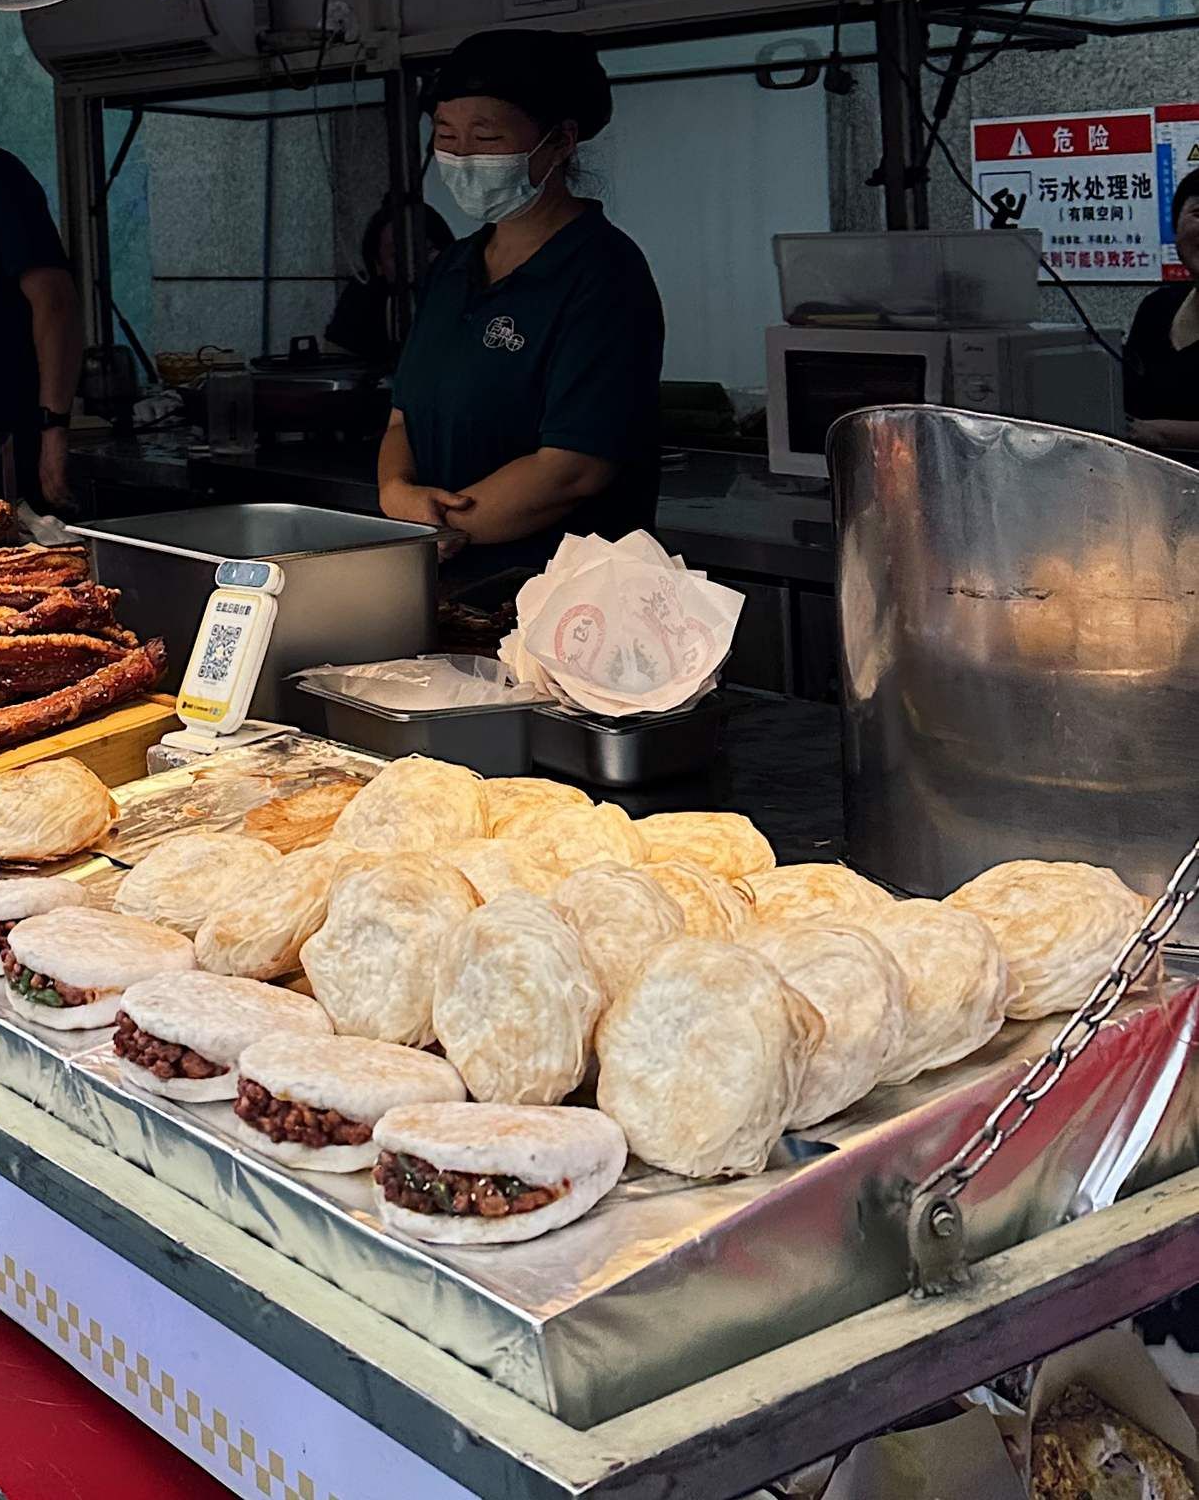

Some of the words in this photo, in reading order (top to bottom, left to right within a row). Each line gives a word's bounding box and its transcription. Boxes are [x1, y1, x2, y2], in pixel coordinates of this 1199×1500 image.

[1053, 124, 1110, 153] 危险
[1038, 173, 1153, 202] 污水处理池
